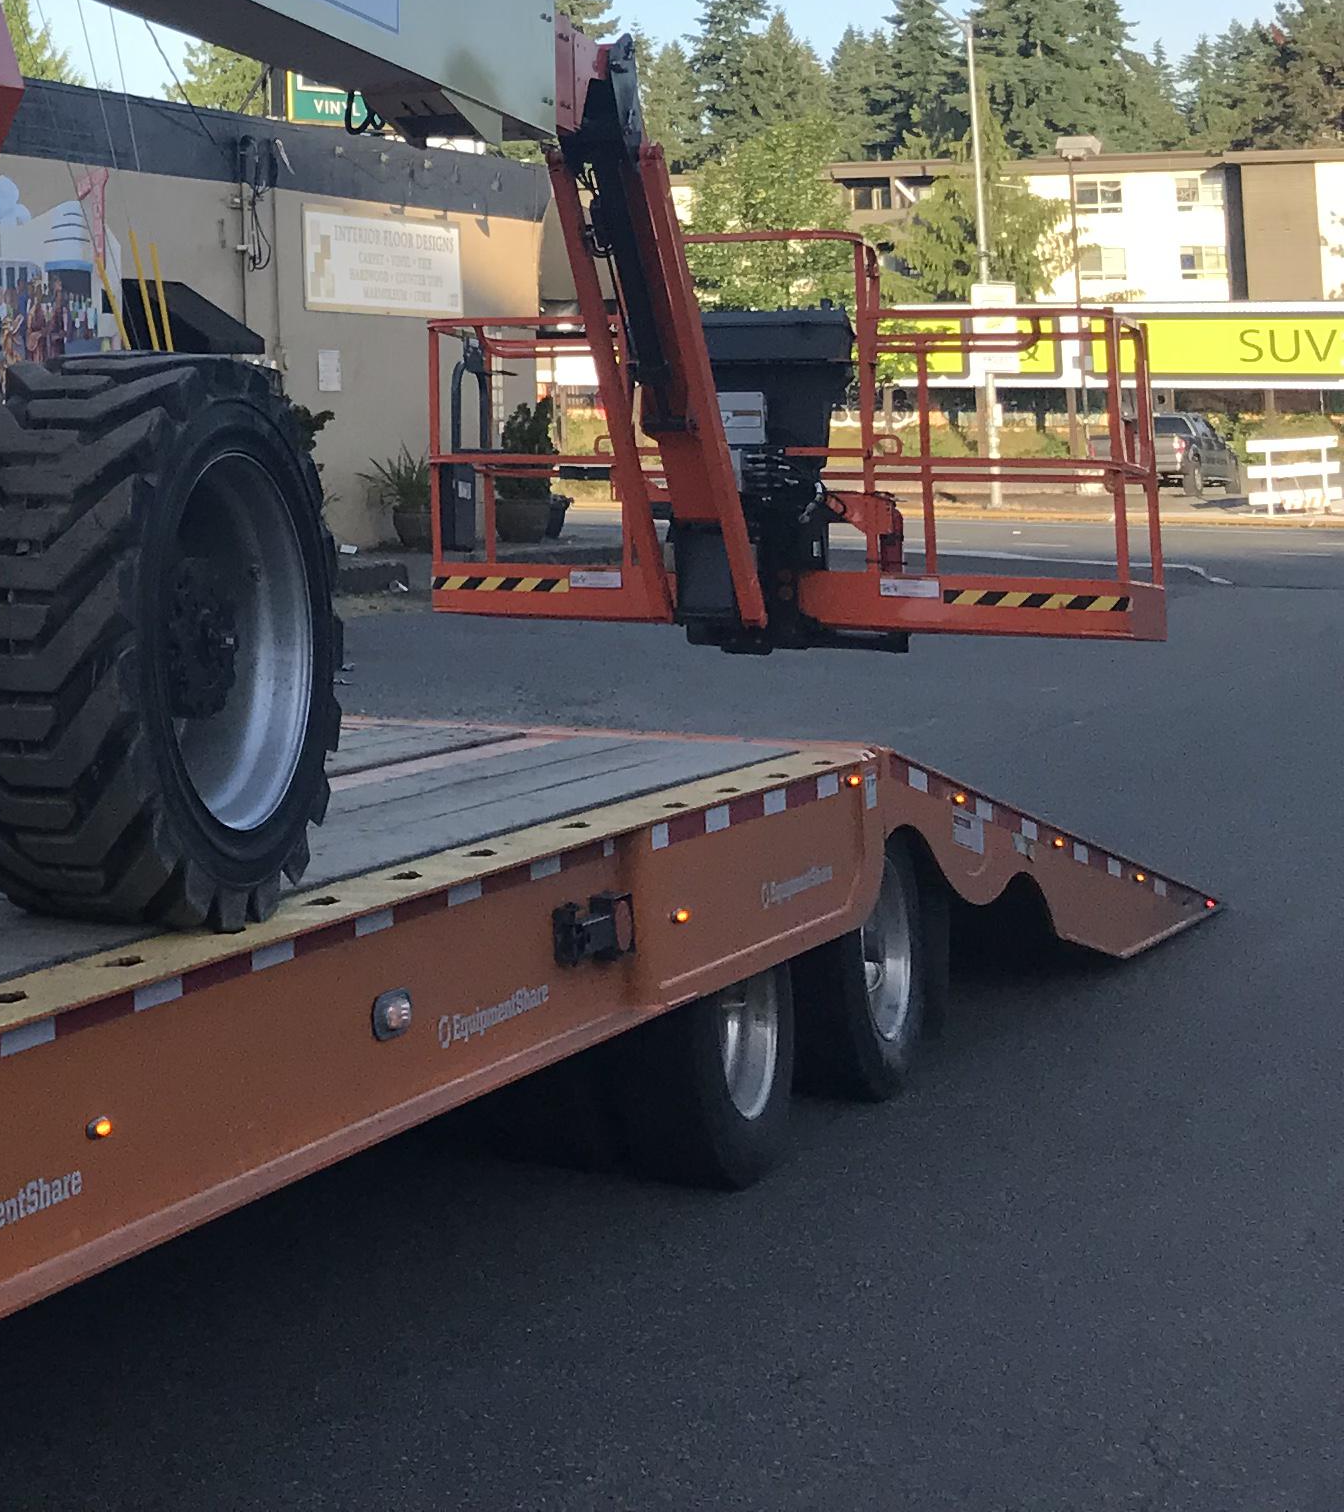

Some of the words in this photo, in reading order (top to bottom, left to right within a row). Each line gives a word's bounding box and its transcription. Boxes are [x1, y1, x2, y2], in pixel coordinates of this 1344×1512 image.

[334, 225, 382, 244] INTERIOR
[383, 230, 416, 250] FLOOR
[416, 234, 454, 254] DESIGNS
[1239, 329, 1337, 363] SUV
